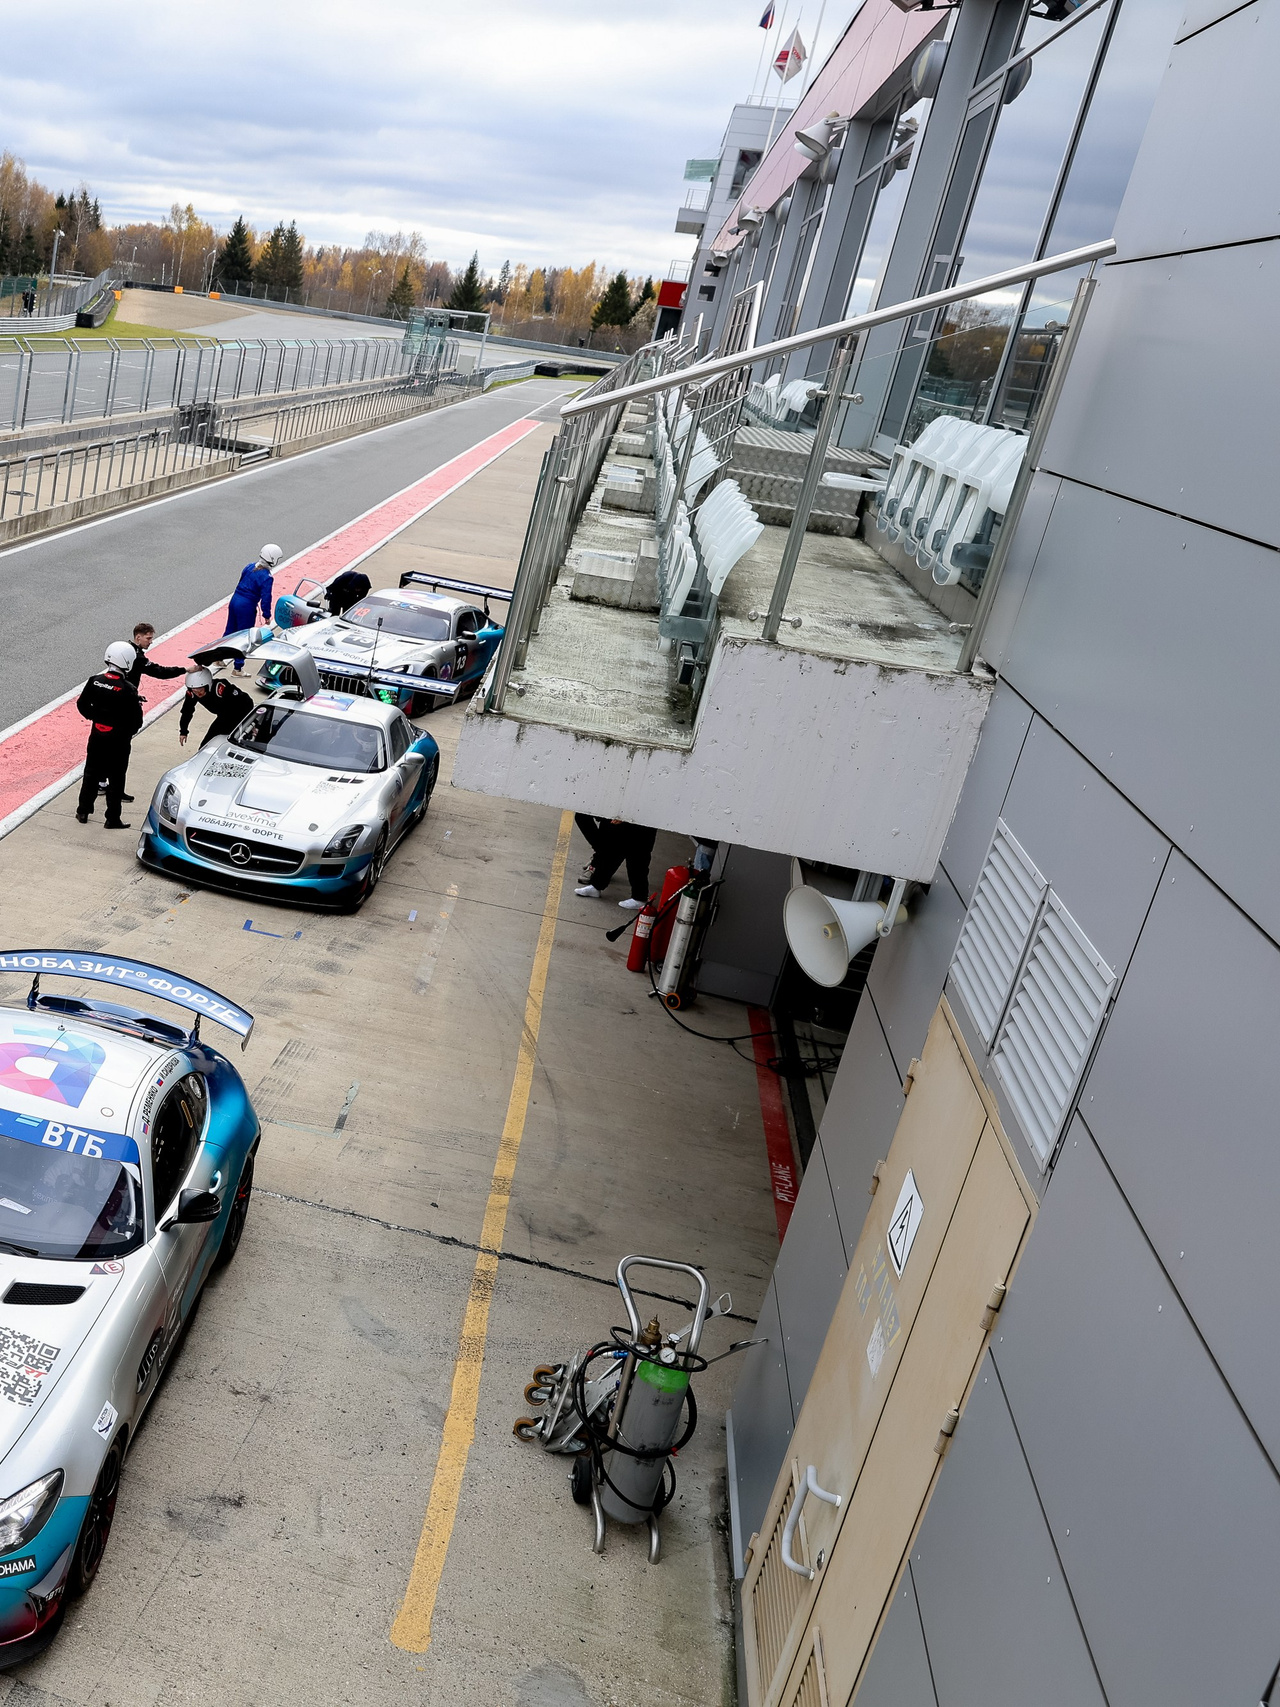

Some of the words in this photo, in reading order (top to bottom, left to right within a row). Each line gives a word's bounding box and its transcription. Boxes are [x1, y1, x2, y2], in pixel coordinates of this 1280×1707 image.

[457, 655, 467, 670] 13
[226, 811, 277, 828] avexima
[252, 828, 284, 840] ФОРТЕ
[147, 976, 241, 1023] ФОРТЕ
[41, 1121, 107, 1159] ВТБ
[772, 1162, 796, 1204] PIT-LANE
